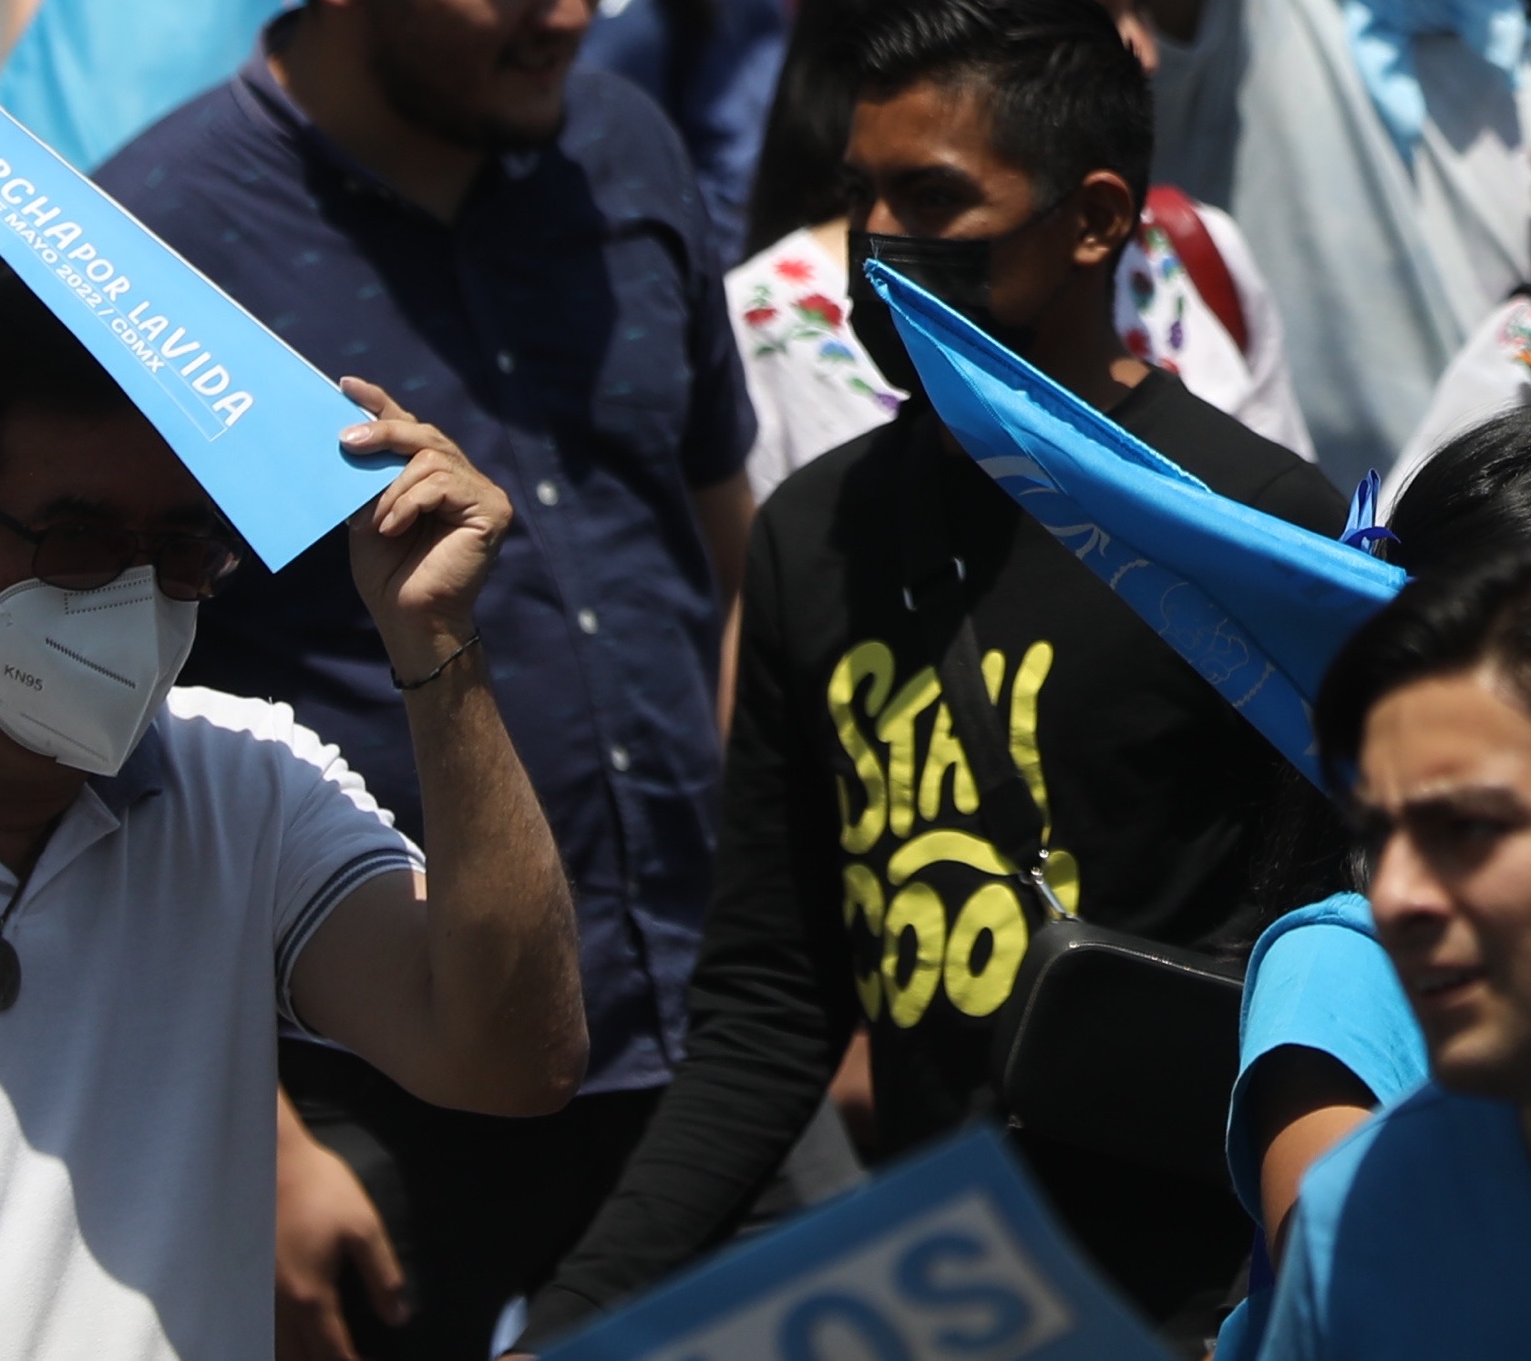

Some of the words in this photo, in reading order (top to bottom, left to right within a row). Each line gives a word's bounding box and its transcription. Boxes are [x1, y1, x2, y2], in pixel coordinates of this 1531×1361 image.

[3, 213, 59, 264] MAYO
[55, 262, 104, 310] 2022
[110, 316, 166, 375] CDMX
[4, 663, 44, 692] KN95
